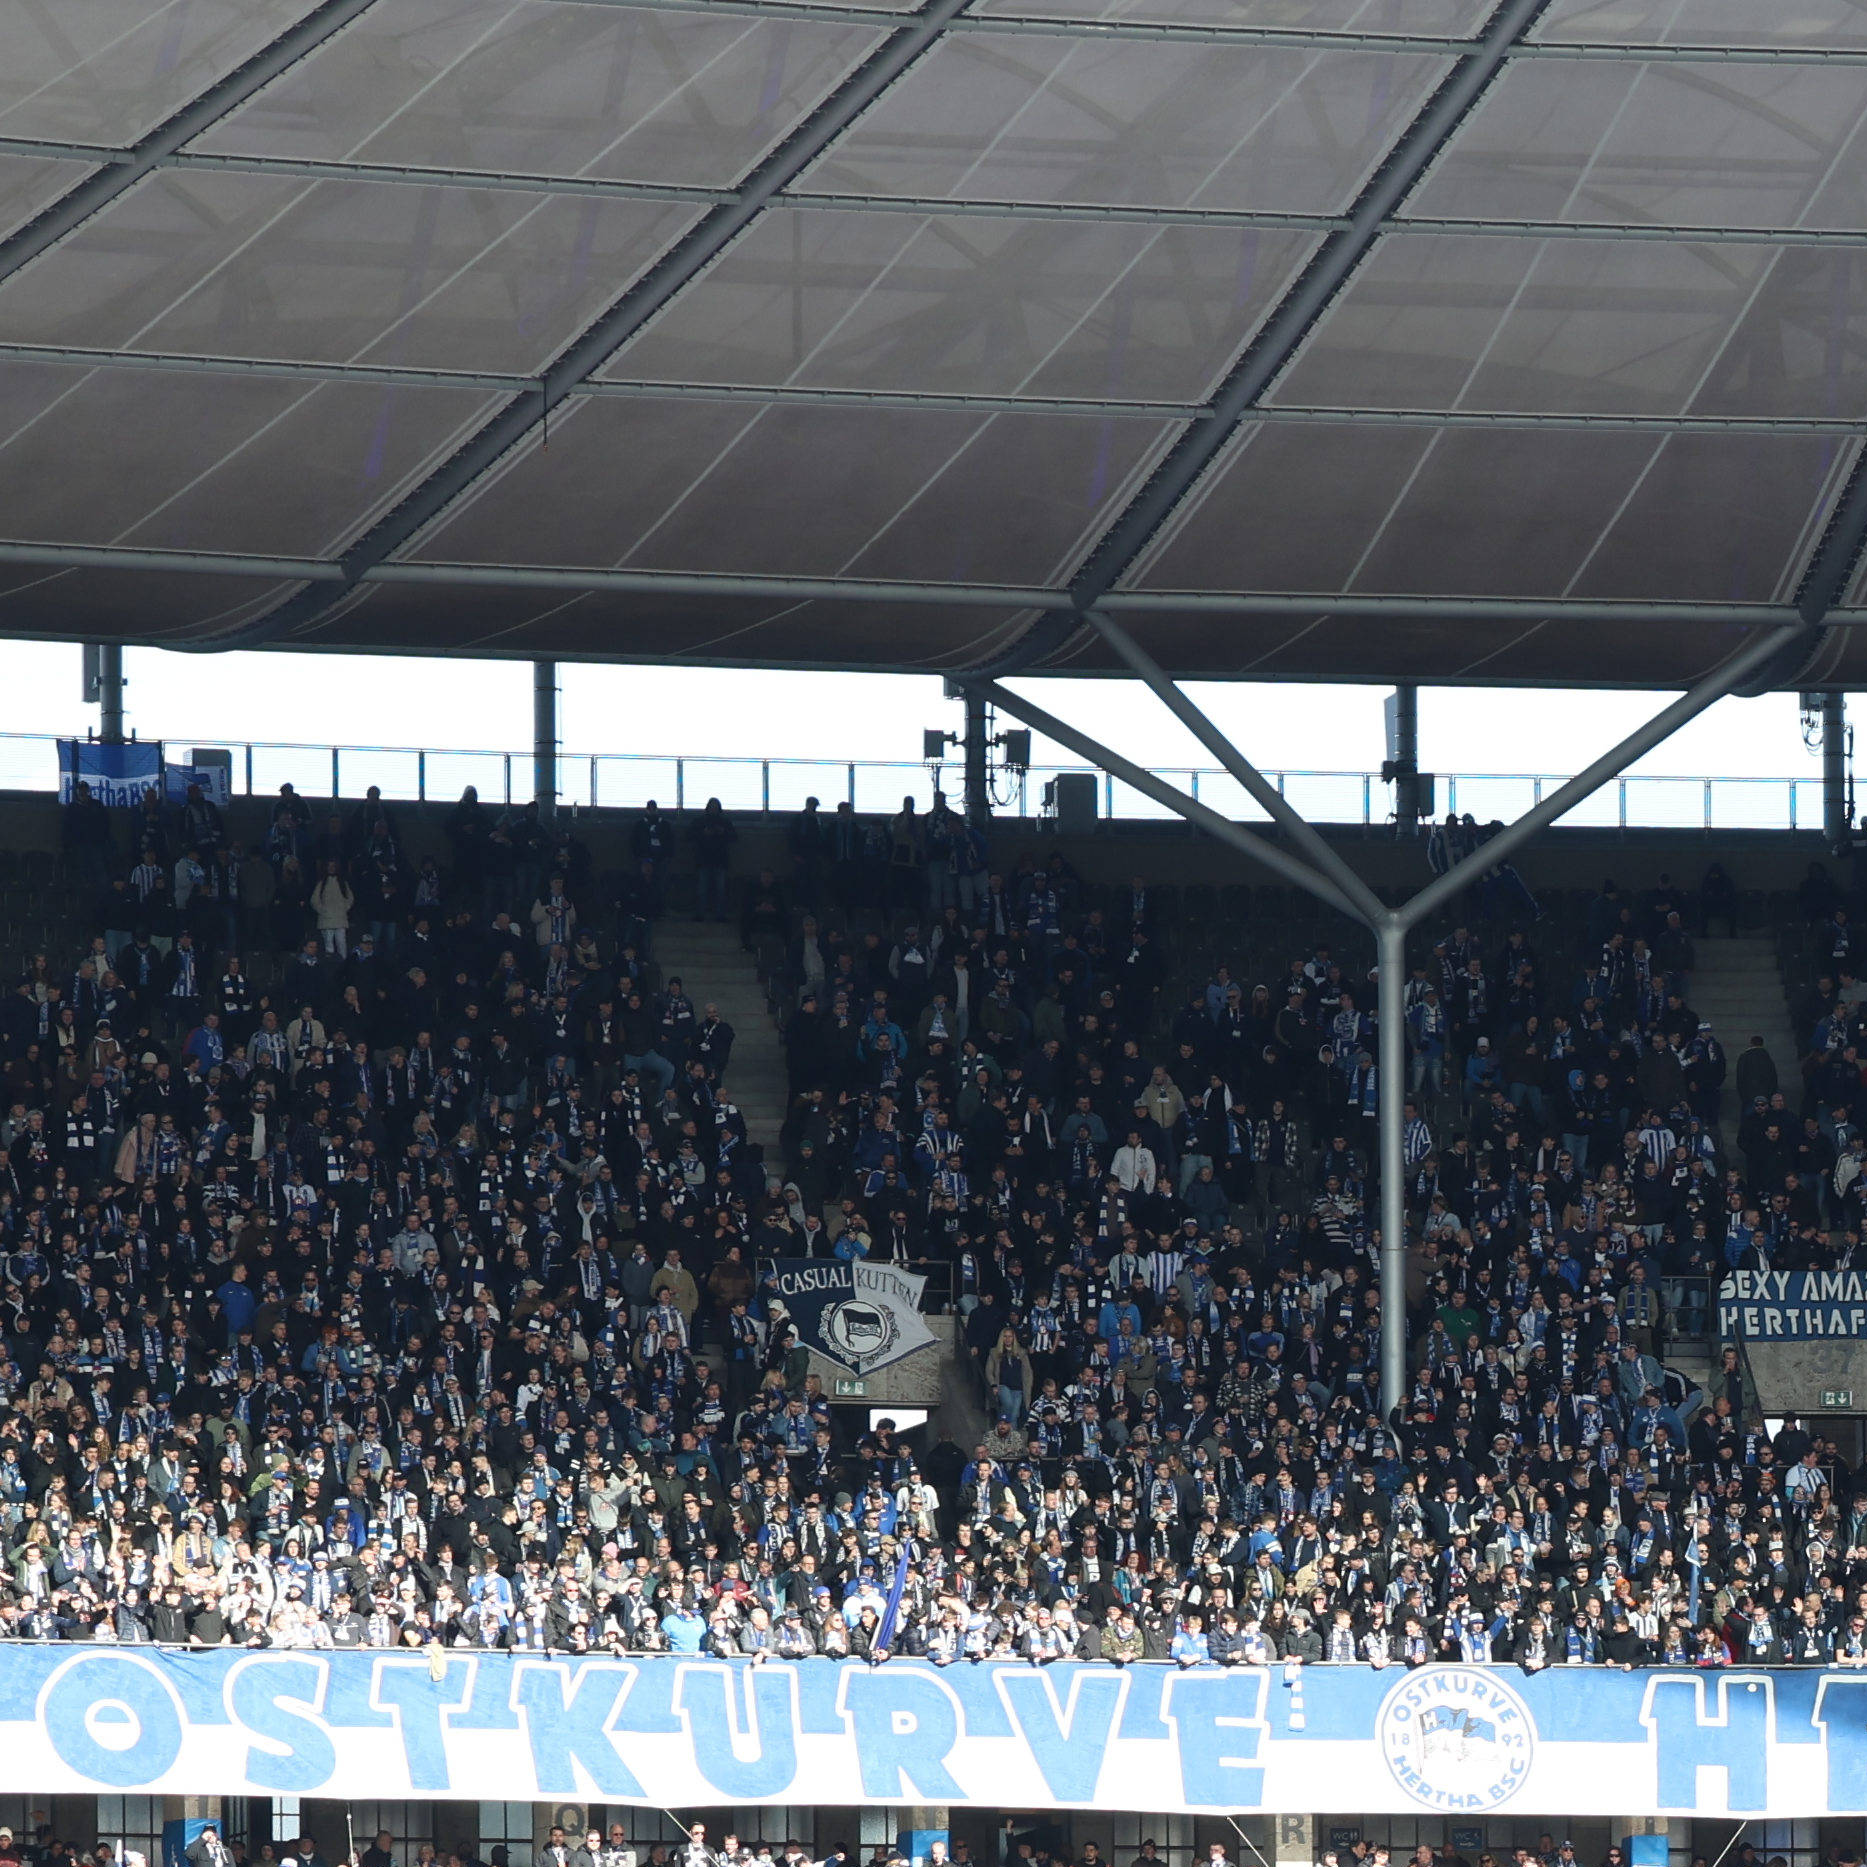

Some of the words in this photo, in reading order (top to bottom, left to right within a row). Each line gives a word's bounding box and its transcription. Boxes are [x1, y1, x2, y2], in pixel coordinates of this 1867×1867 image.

[780, 1266, 852, 1296] CASUAL
[1719, 1270, 1791, 1301] SEXY
[1392, 1674, 1518, 1724] OSTKURVE
[35, 1649, 1271, 1807] OSTKURVE
[1391, 1733, 1411, 1746] 18
[1501, 1733, 1524, 1748] 92
[1393, 1754, 1485, 1809] HERTHA
[1488, 1757, 1526, 1801] BSC
[555, 1802, 587, 1838] Q
[1281, 1813, 1306, 1844] R
